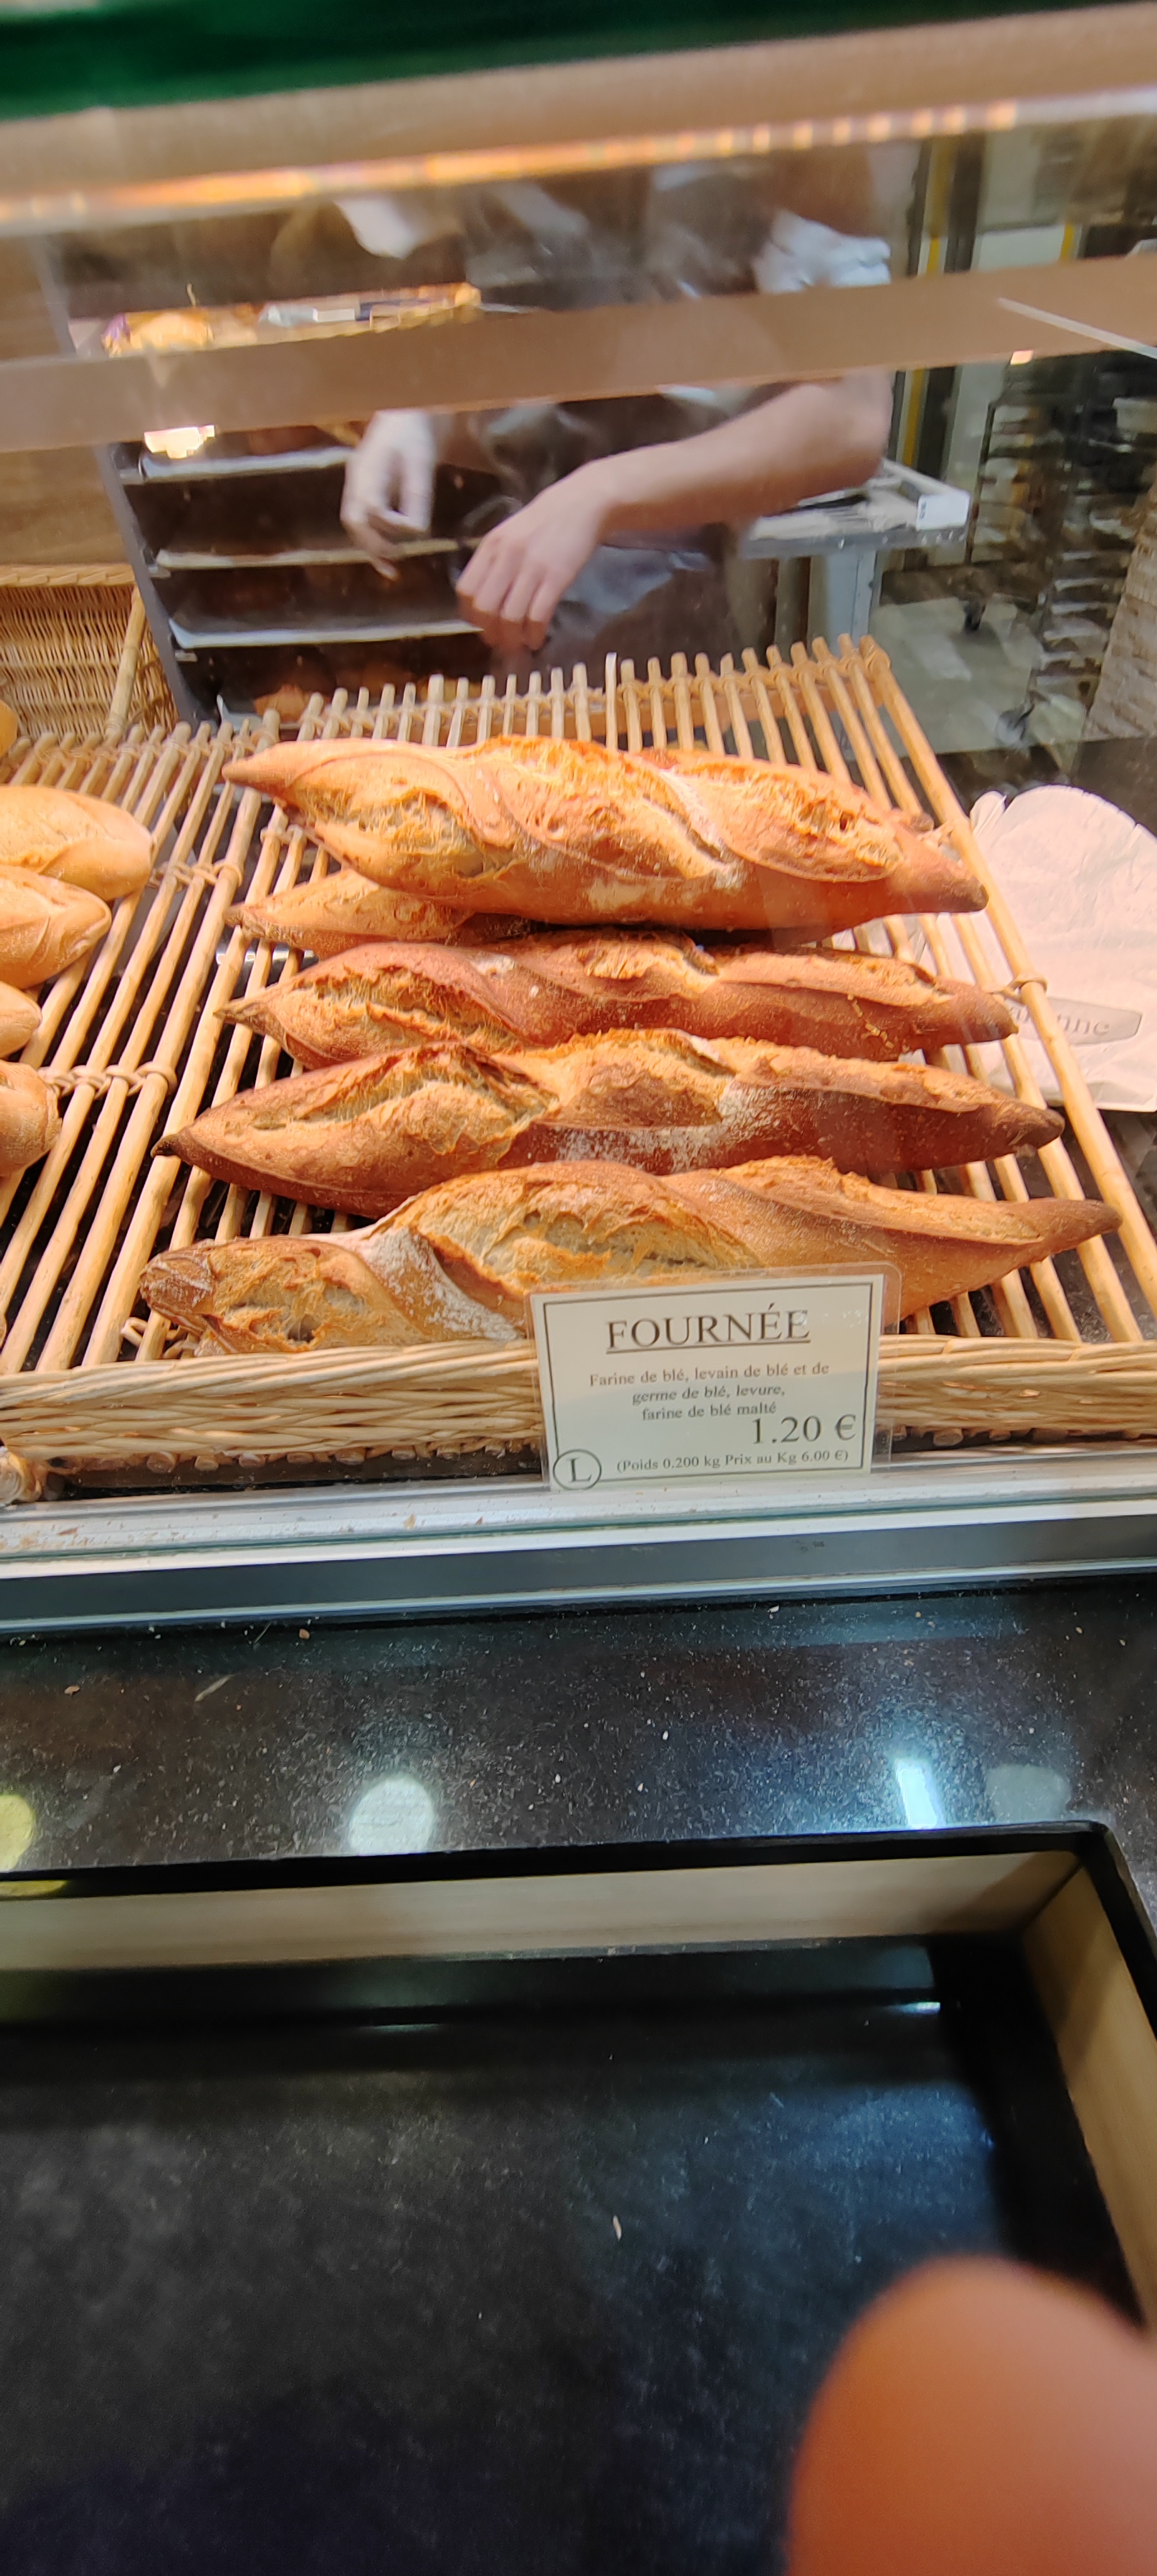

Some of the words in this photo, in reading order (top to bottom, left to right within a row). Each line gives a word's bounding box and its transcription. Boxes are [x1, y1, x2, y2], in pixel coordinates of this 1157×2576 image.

[607, 1302, 811, 1350] FOURNÉE
[589, 1372, 634, 1386] Farine
[640, 1370, 658, 1384] de
[663, 1367, 689, 1383] blé,
[694, 1366, 739, 1380] levain
[743, 1364, 761, 1378] de
[767, 1362, 789, 1376] blé
[793, 1363, 807, 1375] et
[812, 1361, 830, 1375] de
[632, 1392, 677, 1406] germe
[681, 1387, 699, 1400] de
[704, 1384, 731, 1399] blé,
[736, 1383, 786, 1397] levure,
[641, 1407, 683, 1421] farine
[688, 1404, 705, 1418] de
[710, 1402, 731, 1416] blé
[736, 1400, 777, 1416] malté
[752, 1415, 822, 1445] 1.20
[834, 1413, 857, 1441] €
[568, 1457, 593, 1483] L
[616, 1458, 658, 1473] (Poids
[662, 1455, 700, 1469] 0.200
[704, 1453, 721, 1470] kg
[724, 1452, 753, 1466] Prix
[756, 1453, 773, 1464] au
[776, 1450, 797, 1465] Kg
[800, 1449, 831, 1462] 6.00
[834, 1448, 850, 1463] €)
